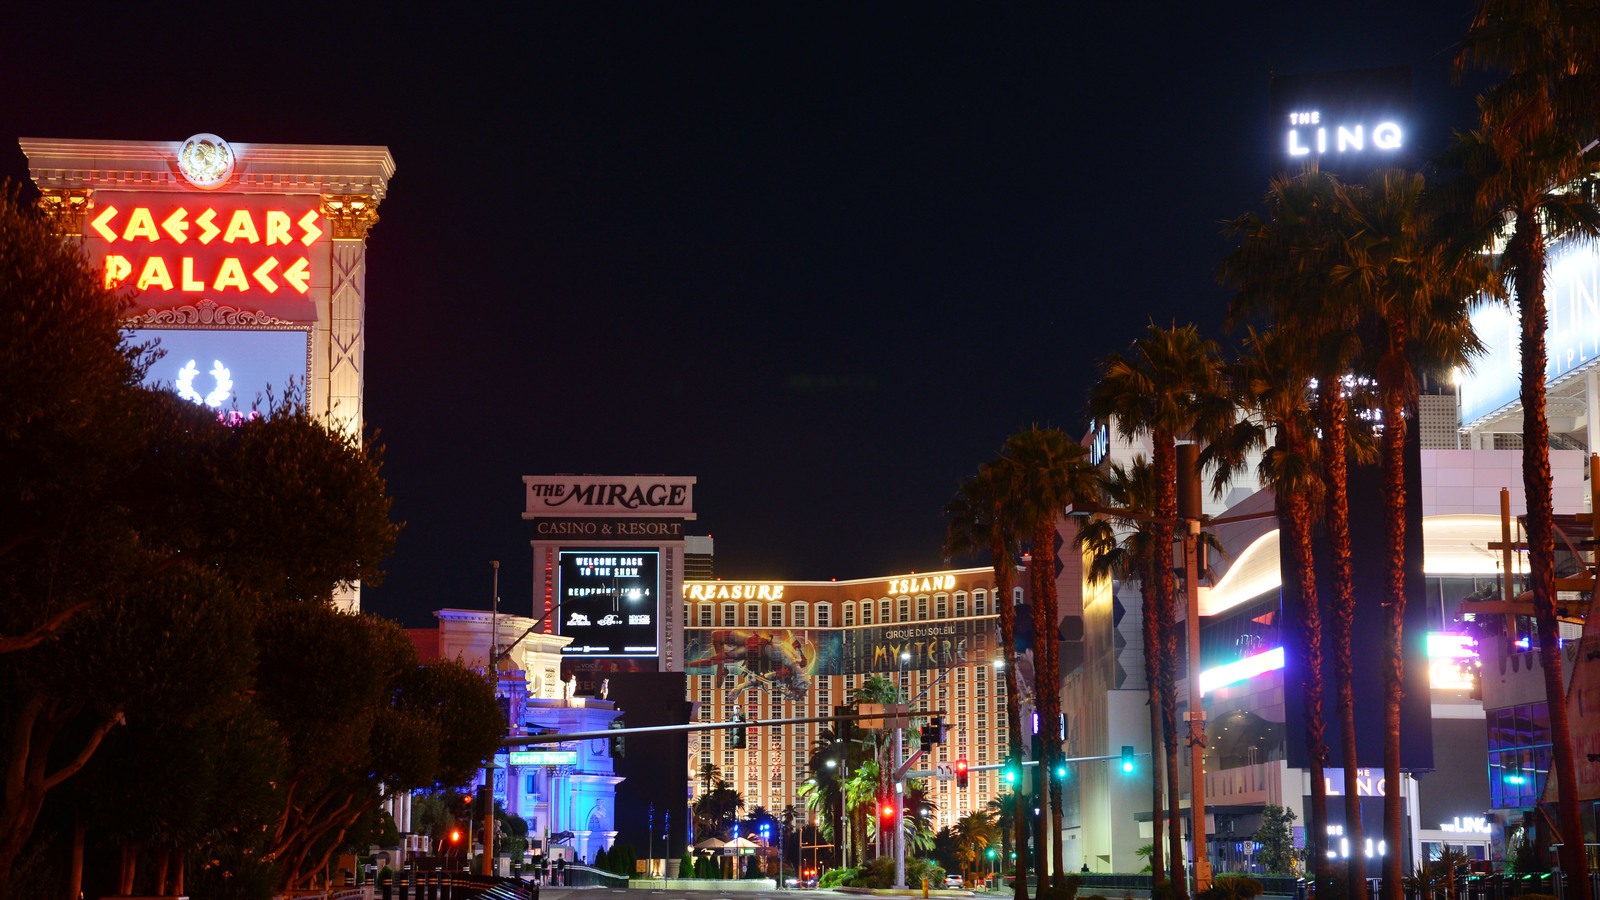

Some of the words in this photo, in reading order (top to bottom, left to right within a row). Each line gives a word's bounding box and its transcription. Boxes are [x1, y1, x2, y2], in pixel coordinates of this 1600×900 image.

[1290, 111, 1320, 124] THE
[1289, 122, 1402, 156] LINQ
[90, 205, 323, 246] CAESARS
[104, 255, 311, 294] PALACE
[532, 484, 565, 497] THE
[544, 484, 687, 509] MIRAGE
[537, 522, 597, 535] CASINO
[601, 523, 613, 535] &
[617, 523, 681, 535] RESORT
[575, 557, 617, 566] WELCOME
[620, 557, 643, 566] BACK
[580, 567, 592, 576] TO
[594, 567, 611, 576] THE
[614, 567, 639, 577] SHOW
[888, 575, 956, 594] ISLAND
[644, 588, 650, 597] 4
[885, 629, 914, 640] CIRQUE
[915, 628, 927, 637] DU
[928, 626, 955, 636] SOLEIL
[512, 753, 541, 764] Caesars
[544, 753, 567, 763] Palace
[1357, 769, 1370, 777] HE
